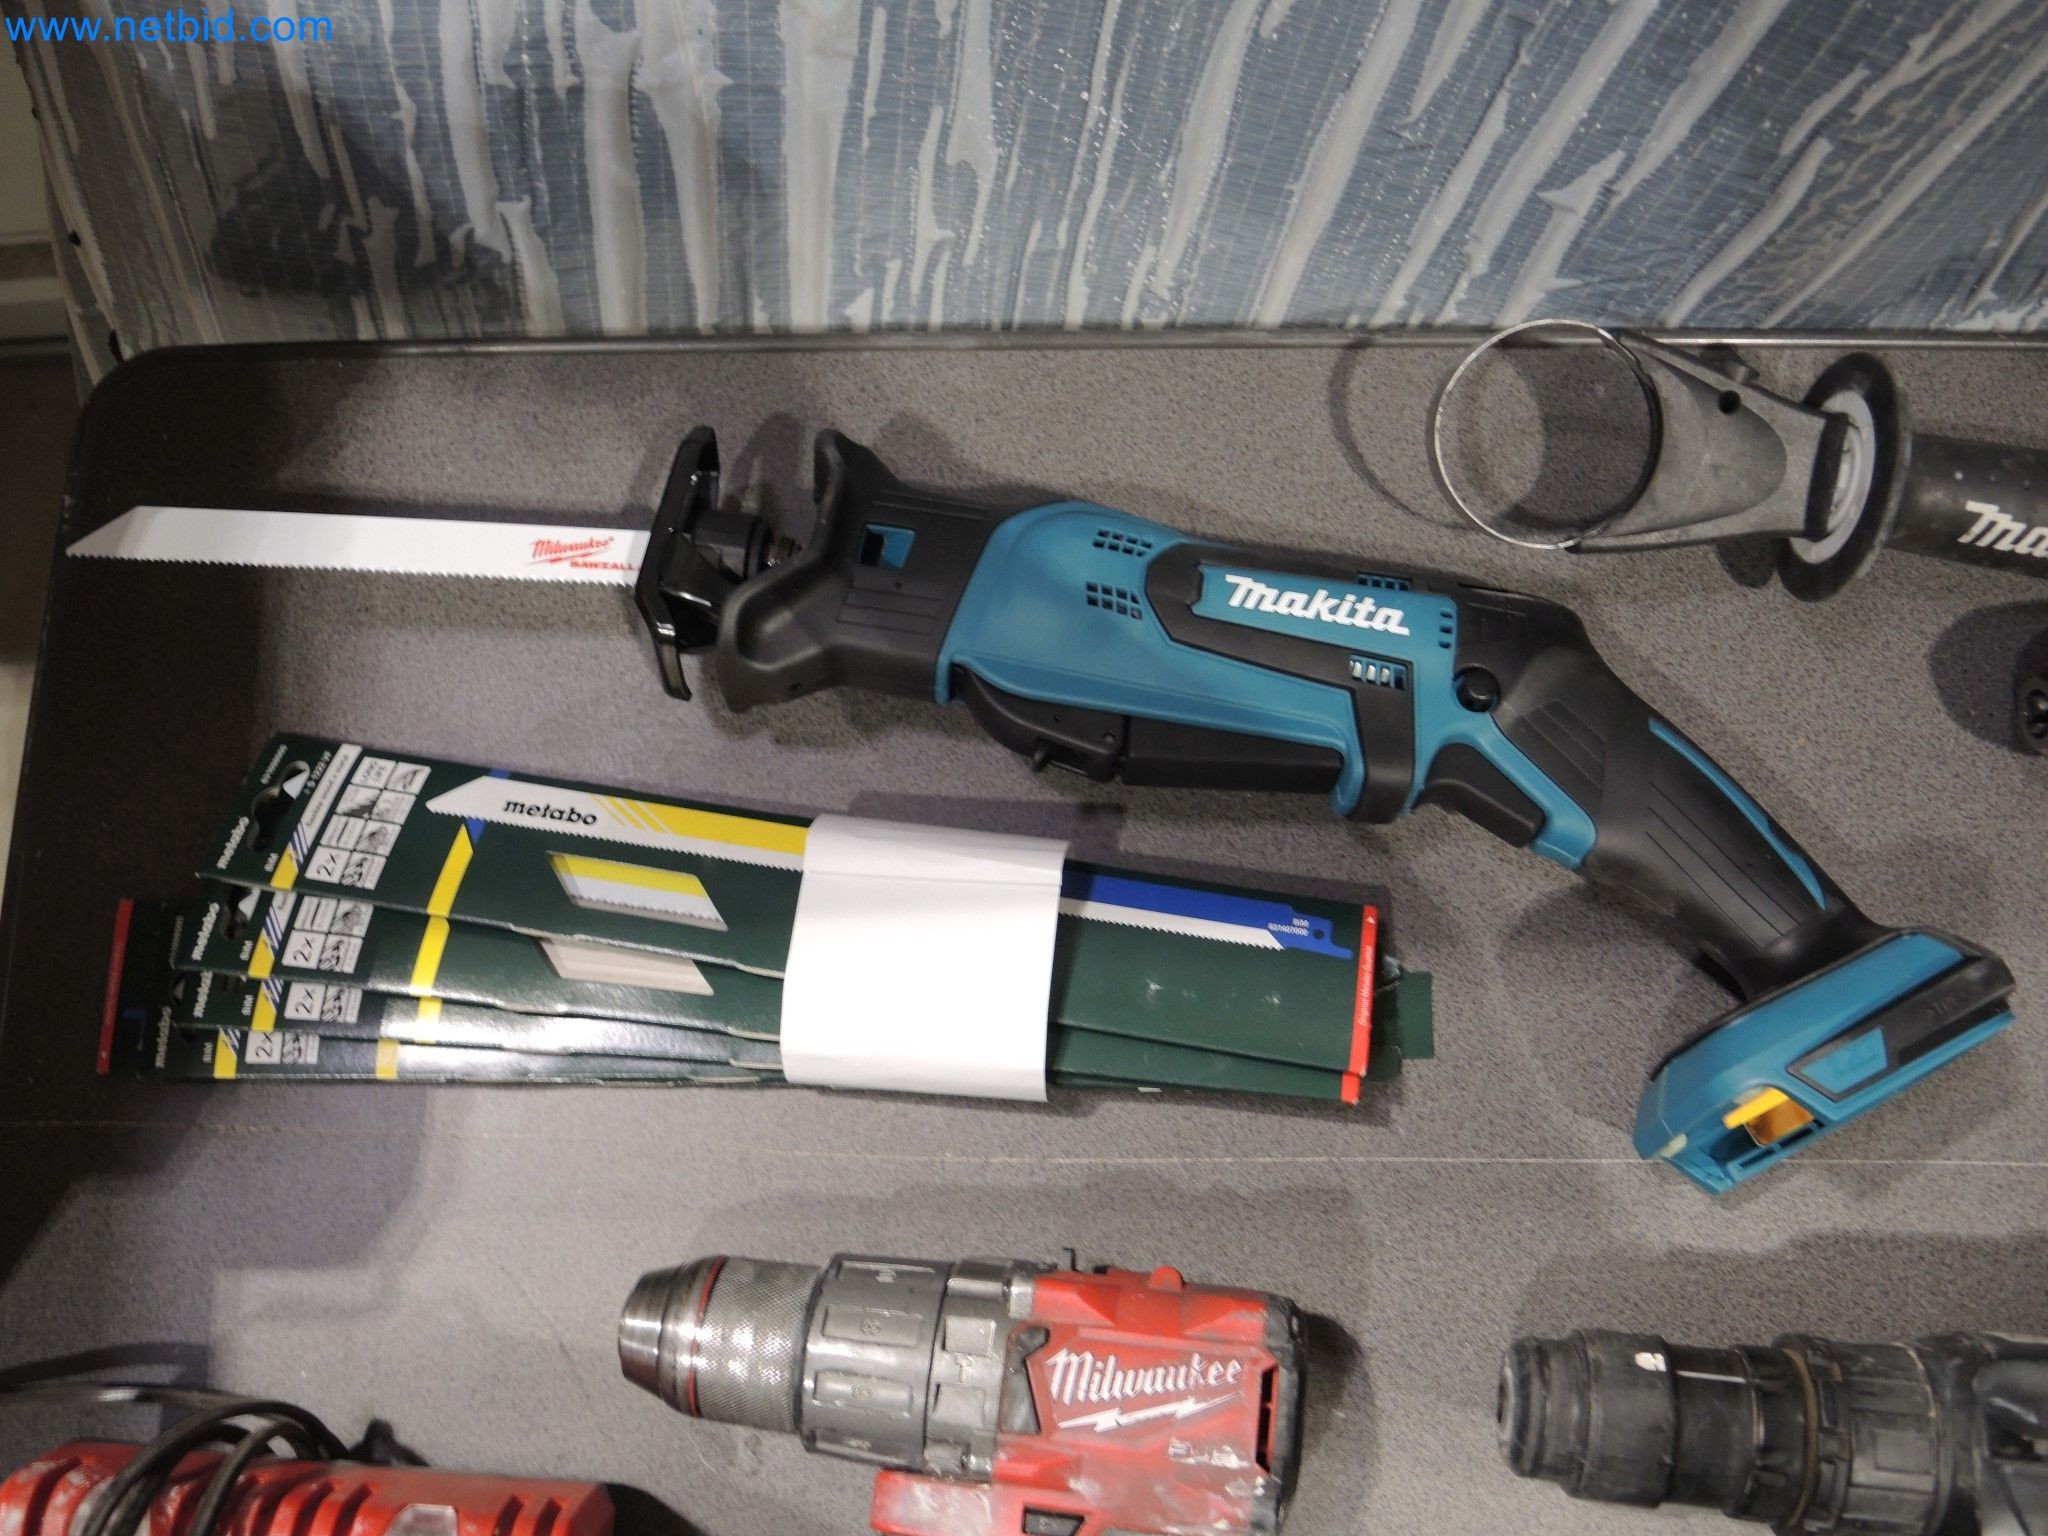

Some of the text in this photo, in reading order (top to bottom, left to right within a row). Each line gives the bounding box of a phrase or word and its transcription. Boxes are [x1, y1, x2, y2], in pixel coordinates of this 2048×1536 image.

[503, 800, 598, 825] metabo
[216, 816, 250, 870] metabo
[191, 903, 220, 961] metabo
[193, 970, 213, 1018] metab
[155, 1006, 172, 1068] metabo
[1045, 1347, 1243, 1406] Milwaukee
